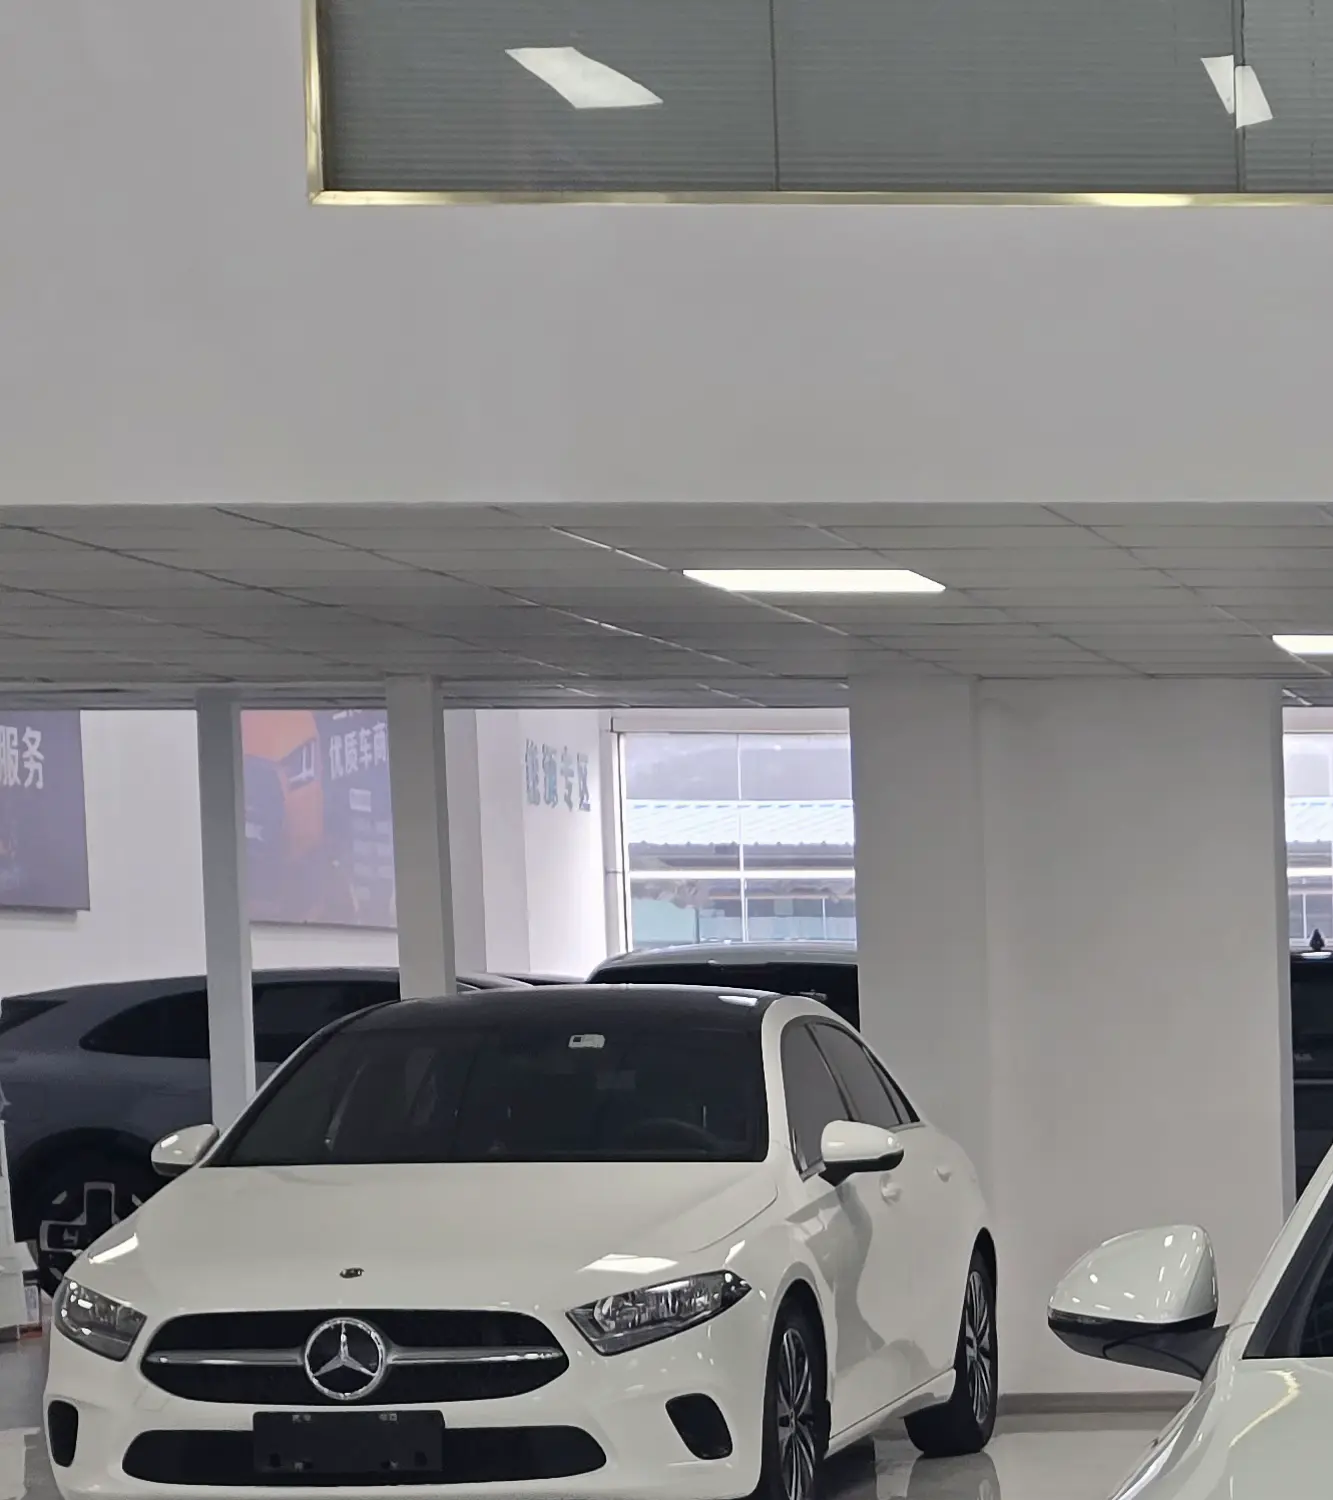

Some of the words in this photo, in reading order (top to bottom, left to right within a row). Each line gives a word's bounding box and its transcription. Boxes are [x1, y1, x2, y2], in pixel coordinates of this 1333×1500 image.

[0, 725, 44, 789] 服务
[329, 721, 387, 781] 优质车商
